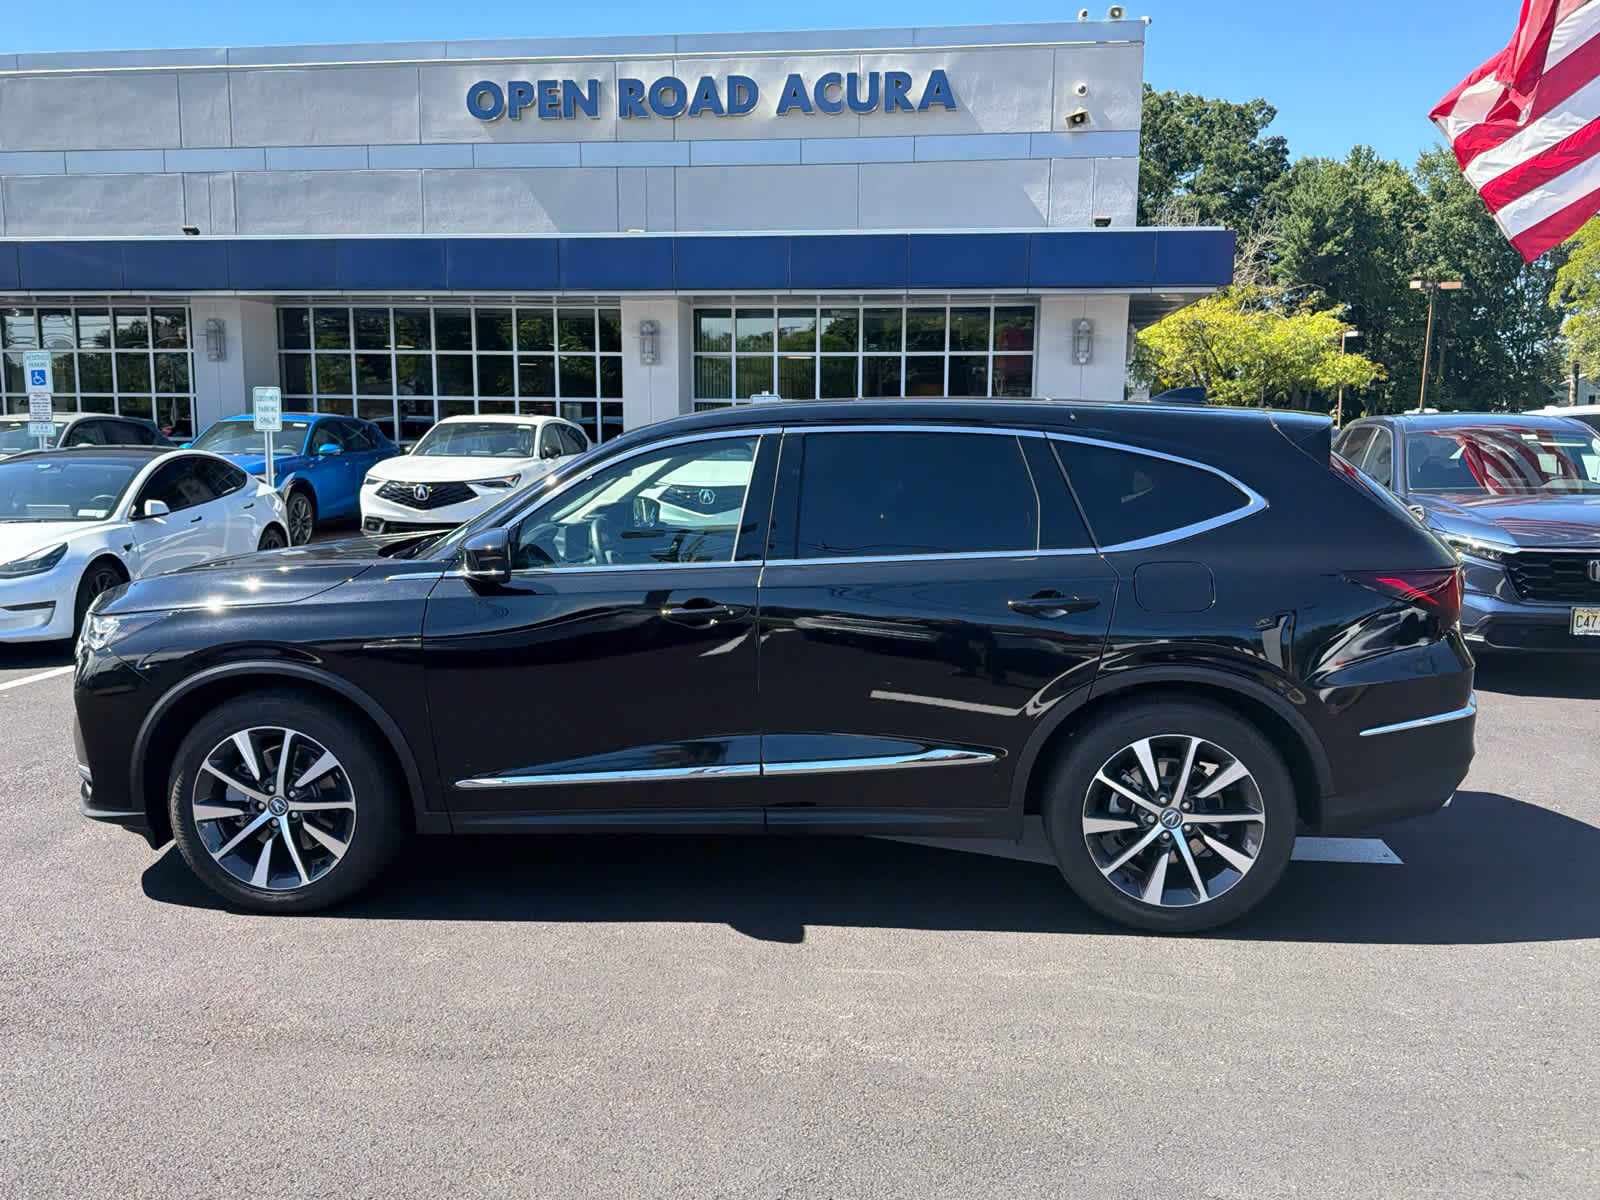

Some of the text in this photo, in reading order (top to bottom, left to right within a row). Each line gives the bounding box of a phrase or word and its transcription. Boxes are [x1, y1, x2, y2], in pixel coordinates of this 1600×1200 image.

[466, 69, 957, 121] OPEN ROAD ACURA
[1575, 615, 1600, 629] C47
